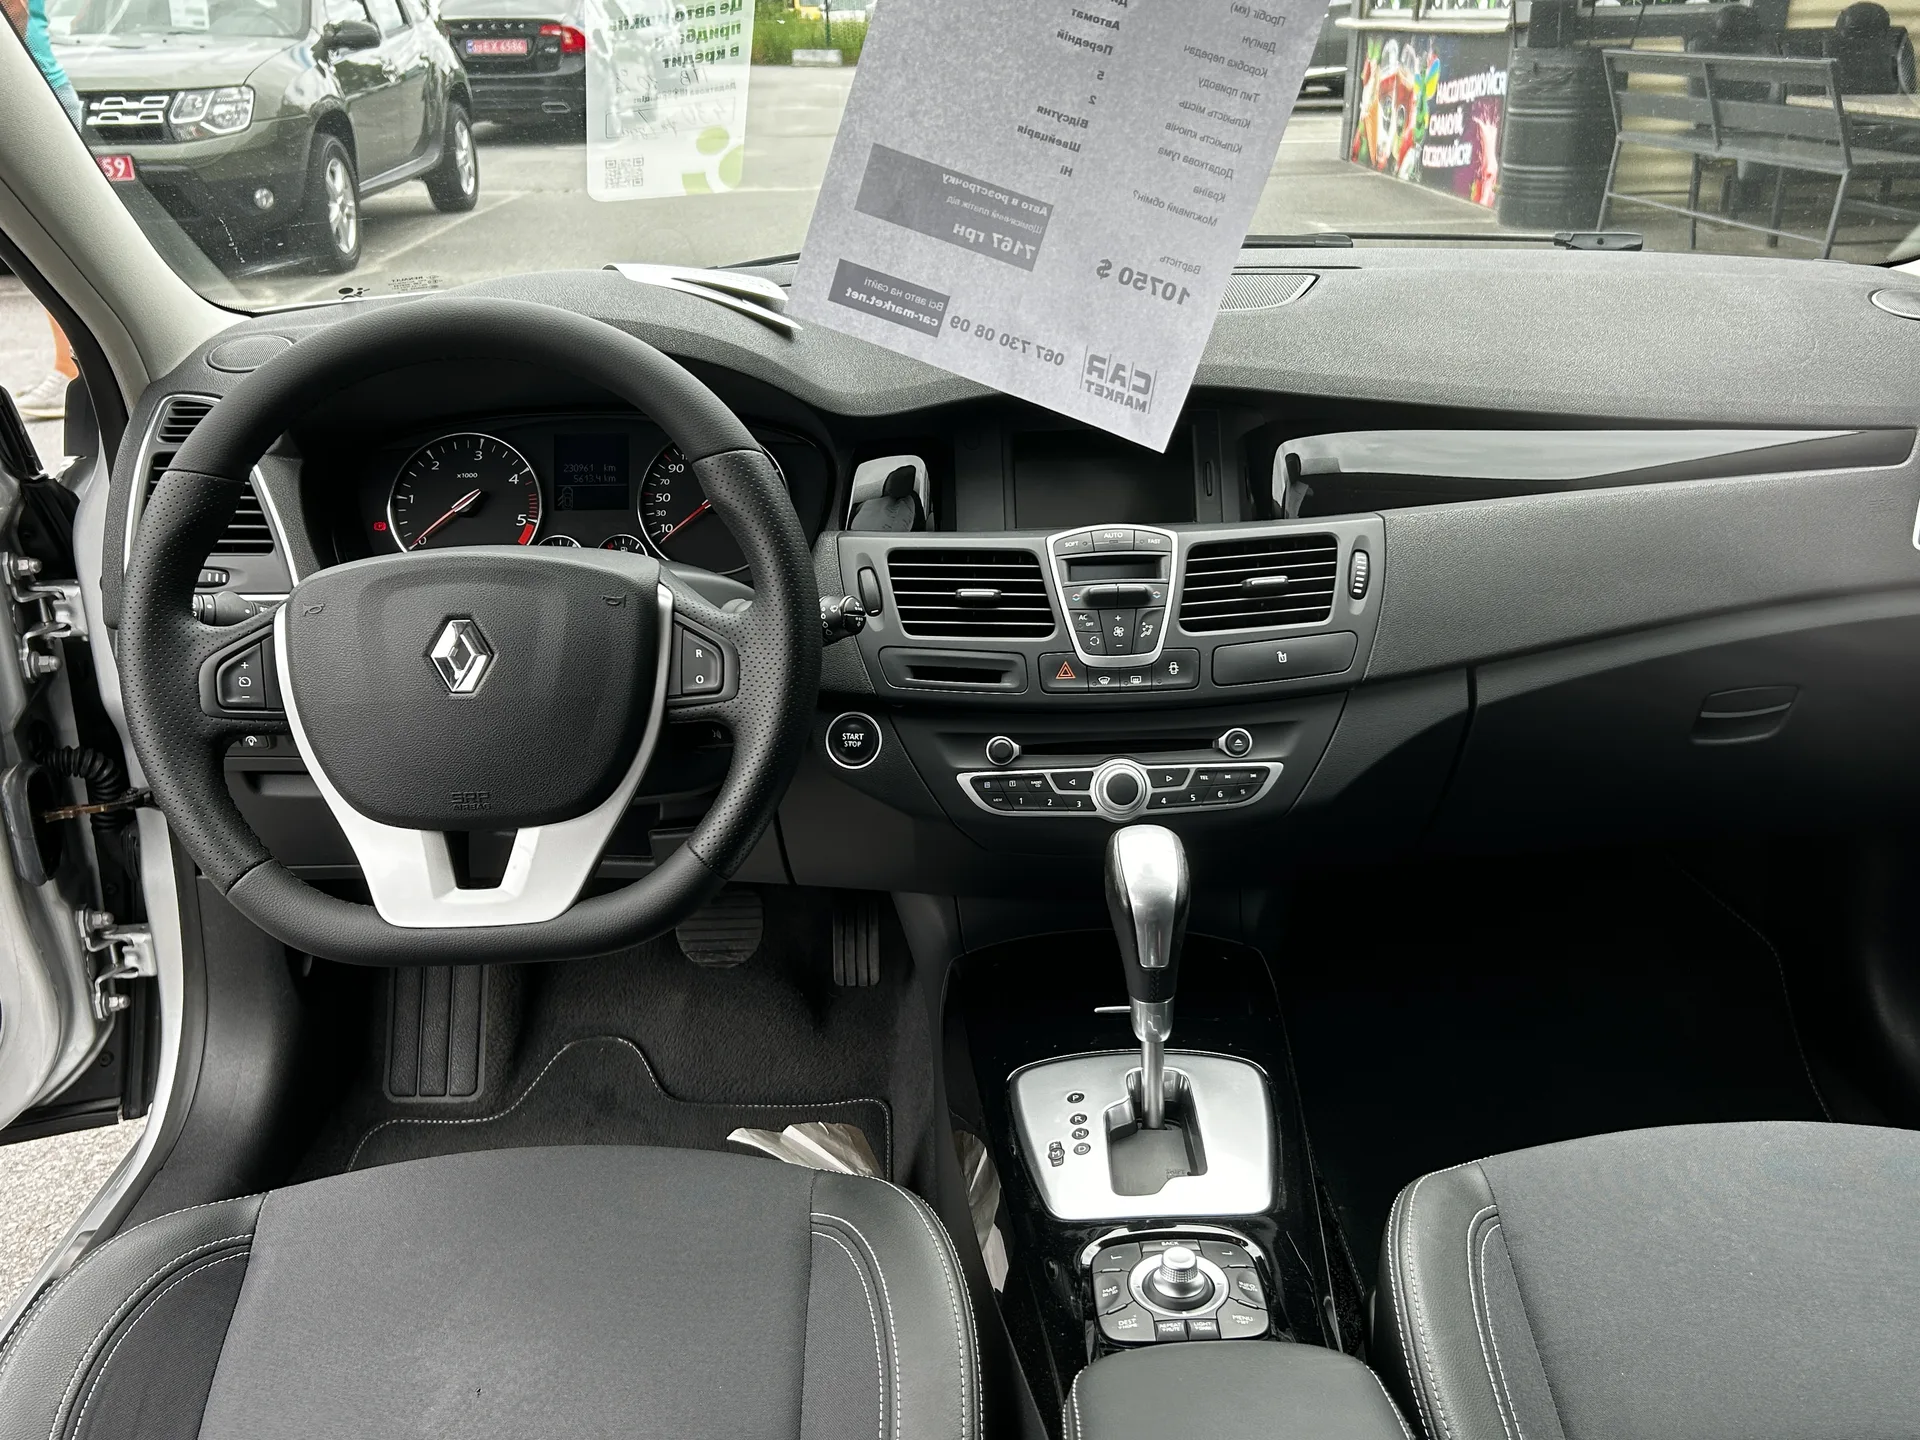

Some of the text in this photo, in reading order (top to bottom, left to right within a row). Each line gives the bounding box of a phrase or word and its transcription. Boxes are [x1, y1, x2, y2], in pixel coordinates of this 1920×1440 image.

[473, 450, 483, 461] 3
[431, 461, 440, 470] 2
[563, 463, 617, 473] 230961 km
[668, 463, 685, 473] 90
[508, 473, 520, 485] 4
[603, 473, 617, 482] km
[659, 478, 670, 486] 70
[408, 494, 414, 503] 1
[655, 493, 671, 503] 50
[515, 514, 527, 526] 5
[660, 524, 674, 533] 10
[695, 648, 703, 658] R
[842, 732, 865, 741] START
[844, 740, 862, 748] STOP
[1190, 794, 1196, 802] 5
[1217, 790, 1223, 798] 6
[1102, 1285, 1117, 1294] MAP
[1118, 1317, 1137, 1326] DEST
[1232, 1314, 1254, 1322] MENU
